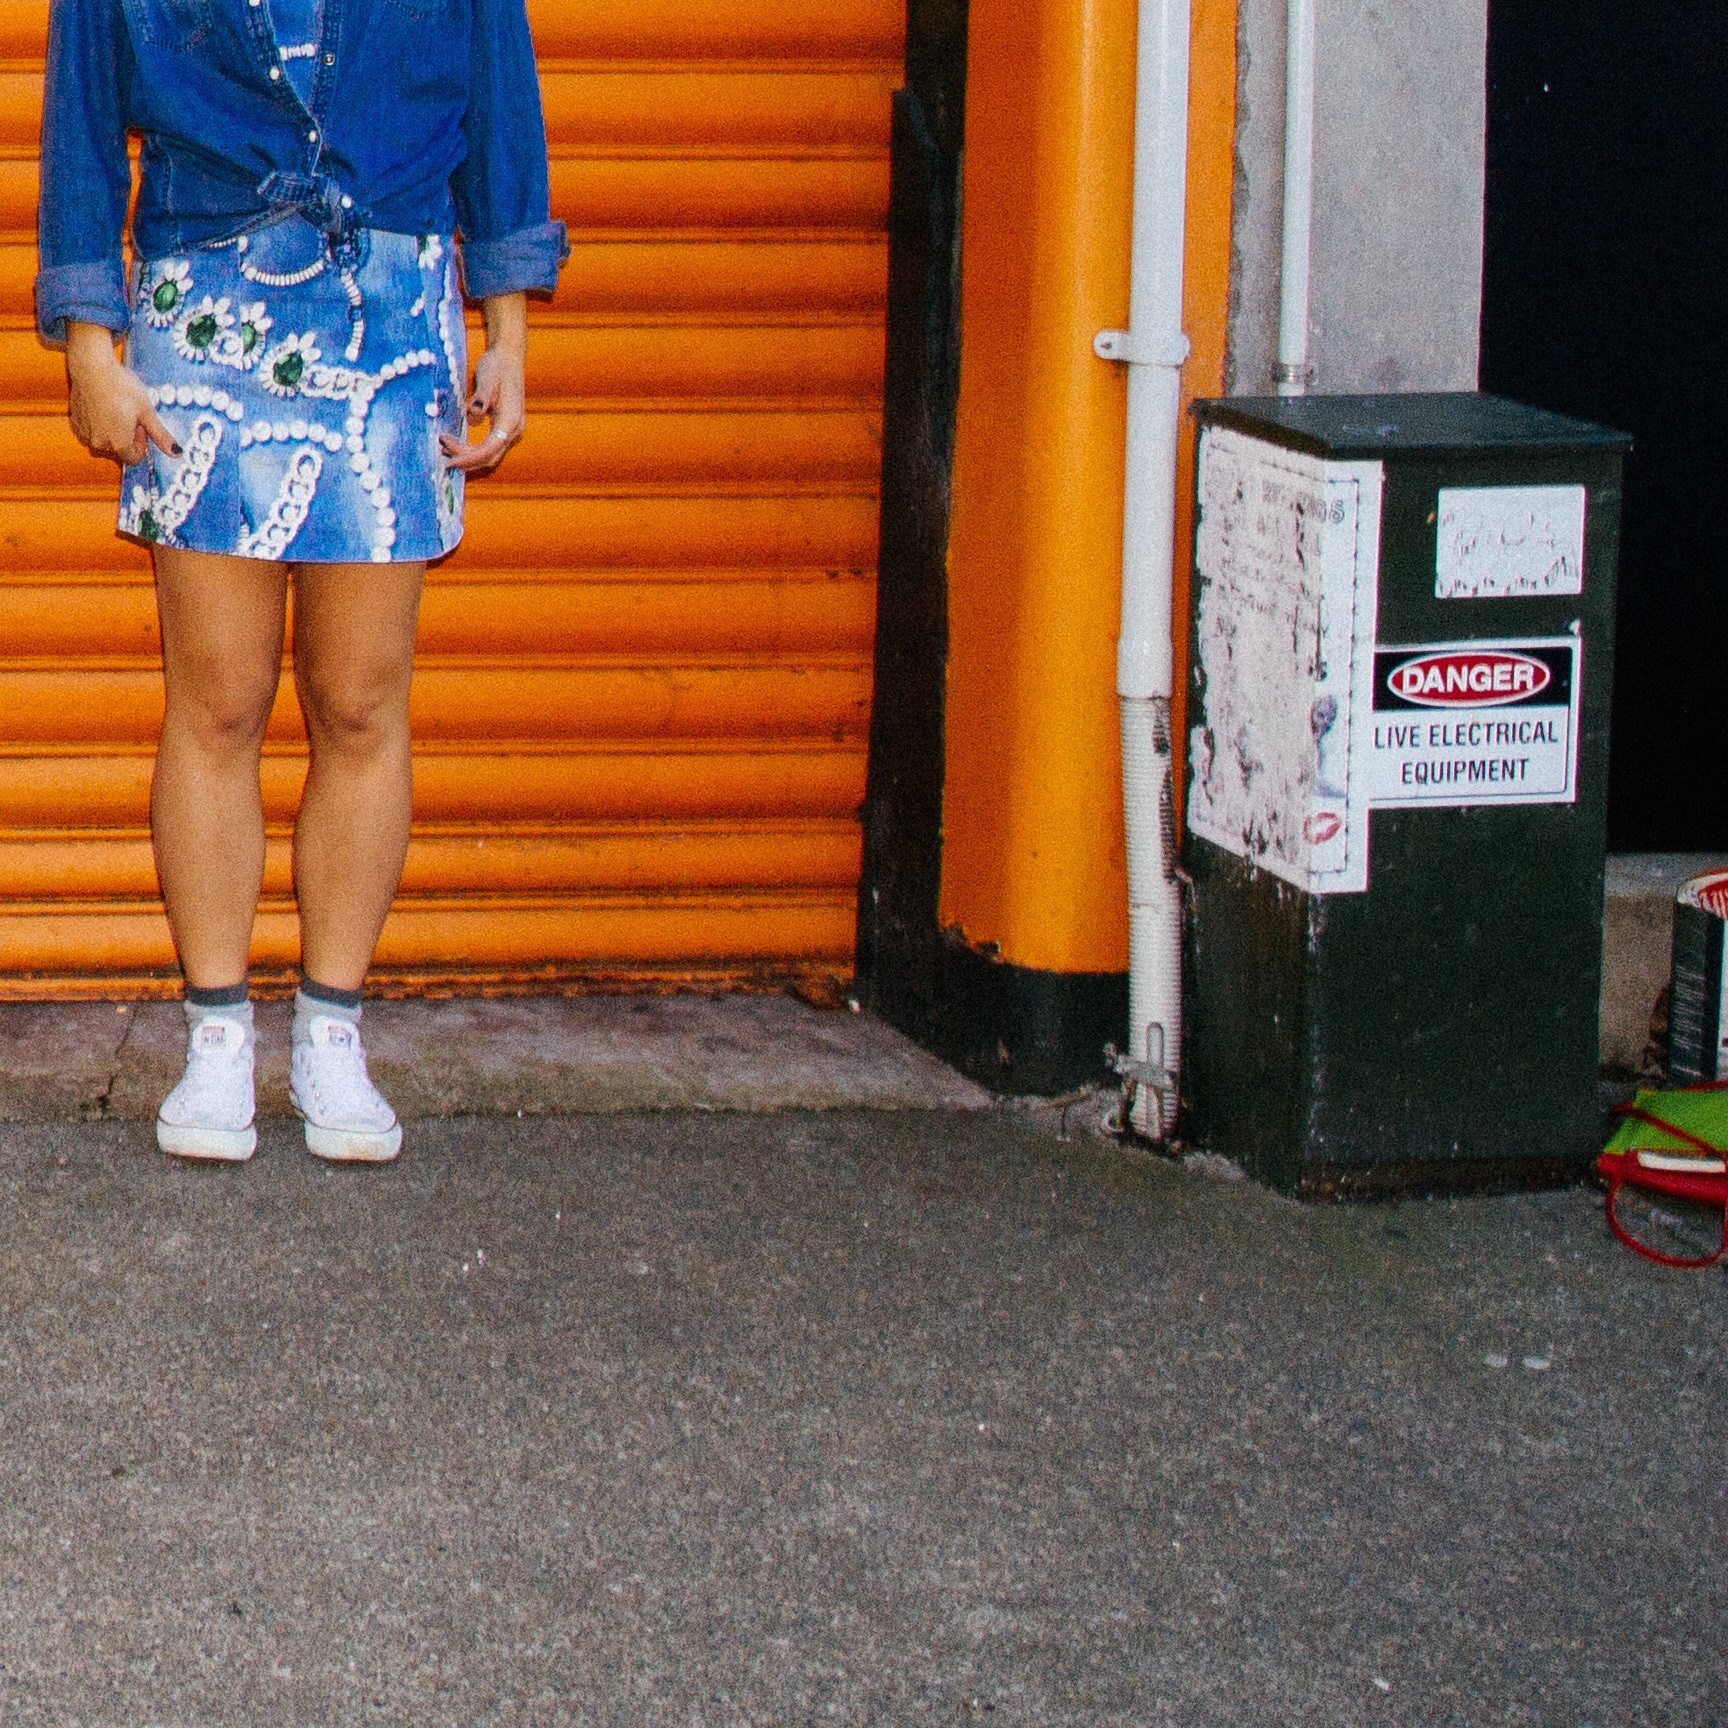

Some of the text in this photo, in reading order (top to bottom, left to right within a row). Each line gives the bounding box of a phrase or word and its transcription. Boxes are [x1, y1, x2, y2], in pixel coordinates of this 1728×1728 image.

[1402, 663, 1536, 694] DANGER
[1374, 719, 1559, 749] LIVE ELECTRICAL
[1402, 758, 1529, 785] EQUIPMENT
